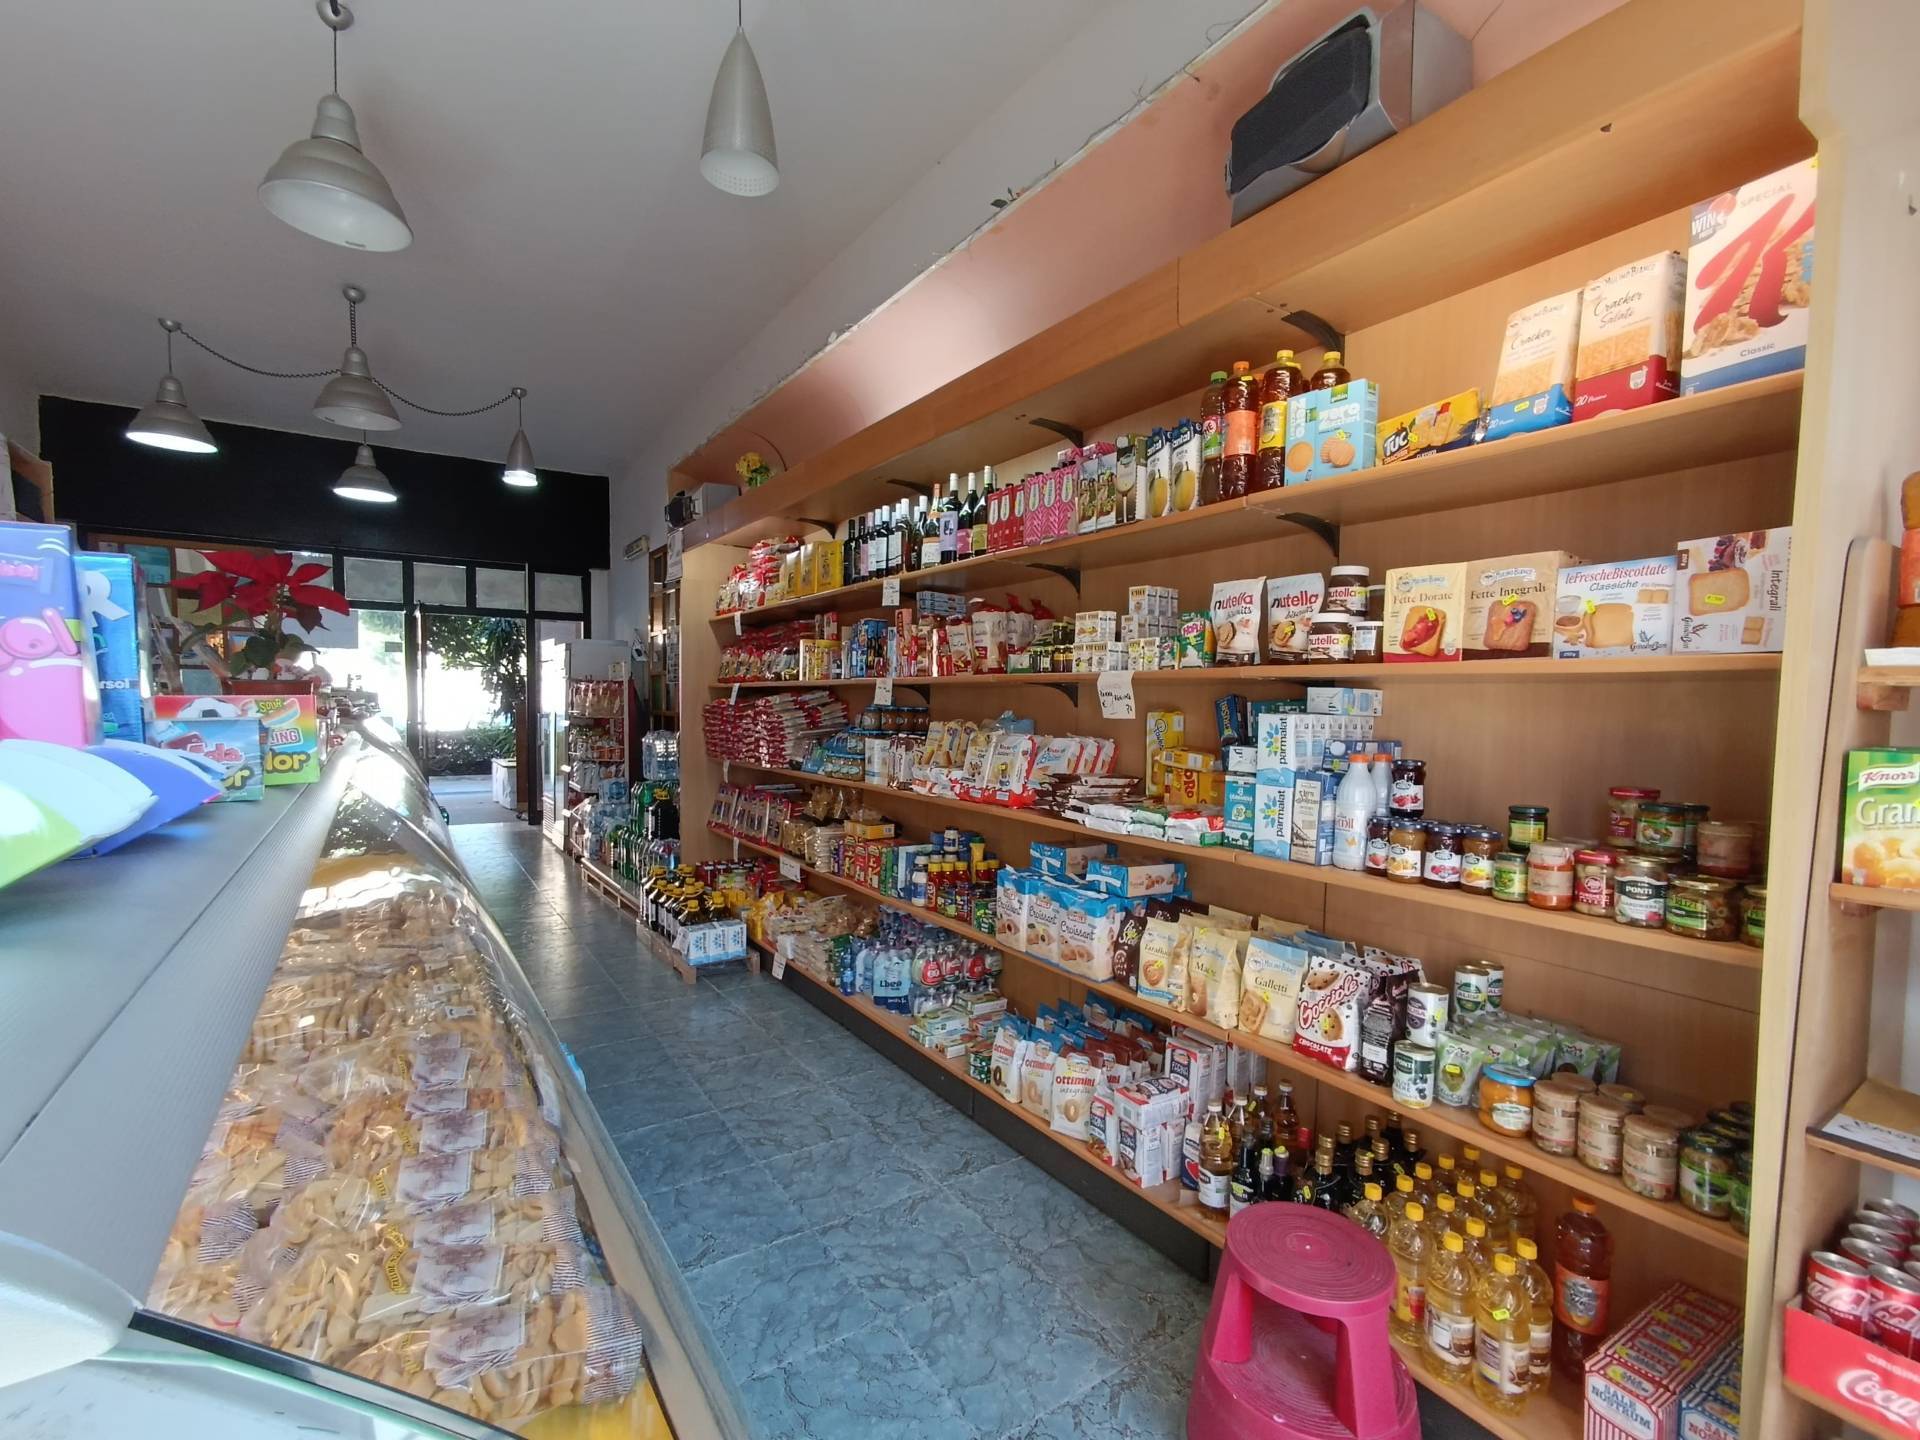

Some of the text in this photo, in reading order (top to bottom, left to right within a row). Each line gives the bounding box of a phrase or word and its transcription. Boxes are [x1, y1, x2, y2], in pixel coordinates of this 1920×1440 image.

[1691, 211, 1717, 236] WIN
[1593, 291, 1643, 317] Cracker
[1511, 328, 1552, 351] Cracker
[1740, 343, 1776, 357] Classic
[1470, 582, 1547, 600] Fette Integrali
[1589, 579, 1639, 592] Classiche
[1768, 570, 1784, 612] Integrali
[1214, 592, 1254, 611] nutella
[1271, 591, 1319, 609] nutella
[1393, 592, 1454, 604] Fette Dorate
[258, 699, 283, 714] SOUR
[1279, 717, 1288, 765] parmalat
[1861, 771, 1916, 784] Knorr
[1276, 790, 1286, 838] parmalat
[1625, 885, 1652, 895] PONTI
[1029, 905, 1057, 926] Croissant
[1060, 920, 1096, 941] Croissant
[1254, 976, 1288, 993] Galletti
[1300, 974, 1359, 1029] Gocciole
[1298, 1038, 1333, 1055] CHOCOLATE
[1604, 1384, 1637, 1409] SALE
[1591, 1384, 1652, 1431] NOSTRUM
